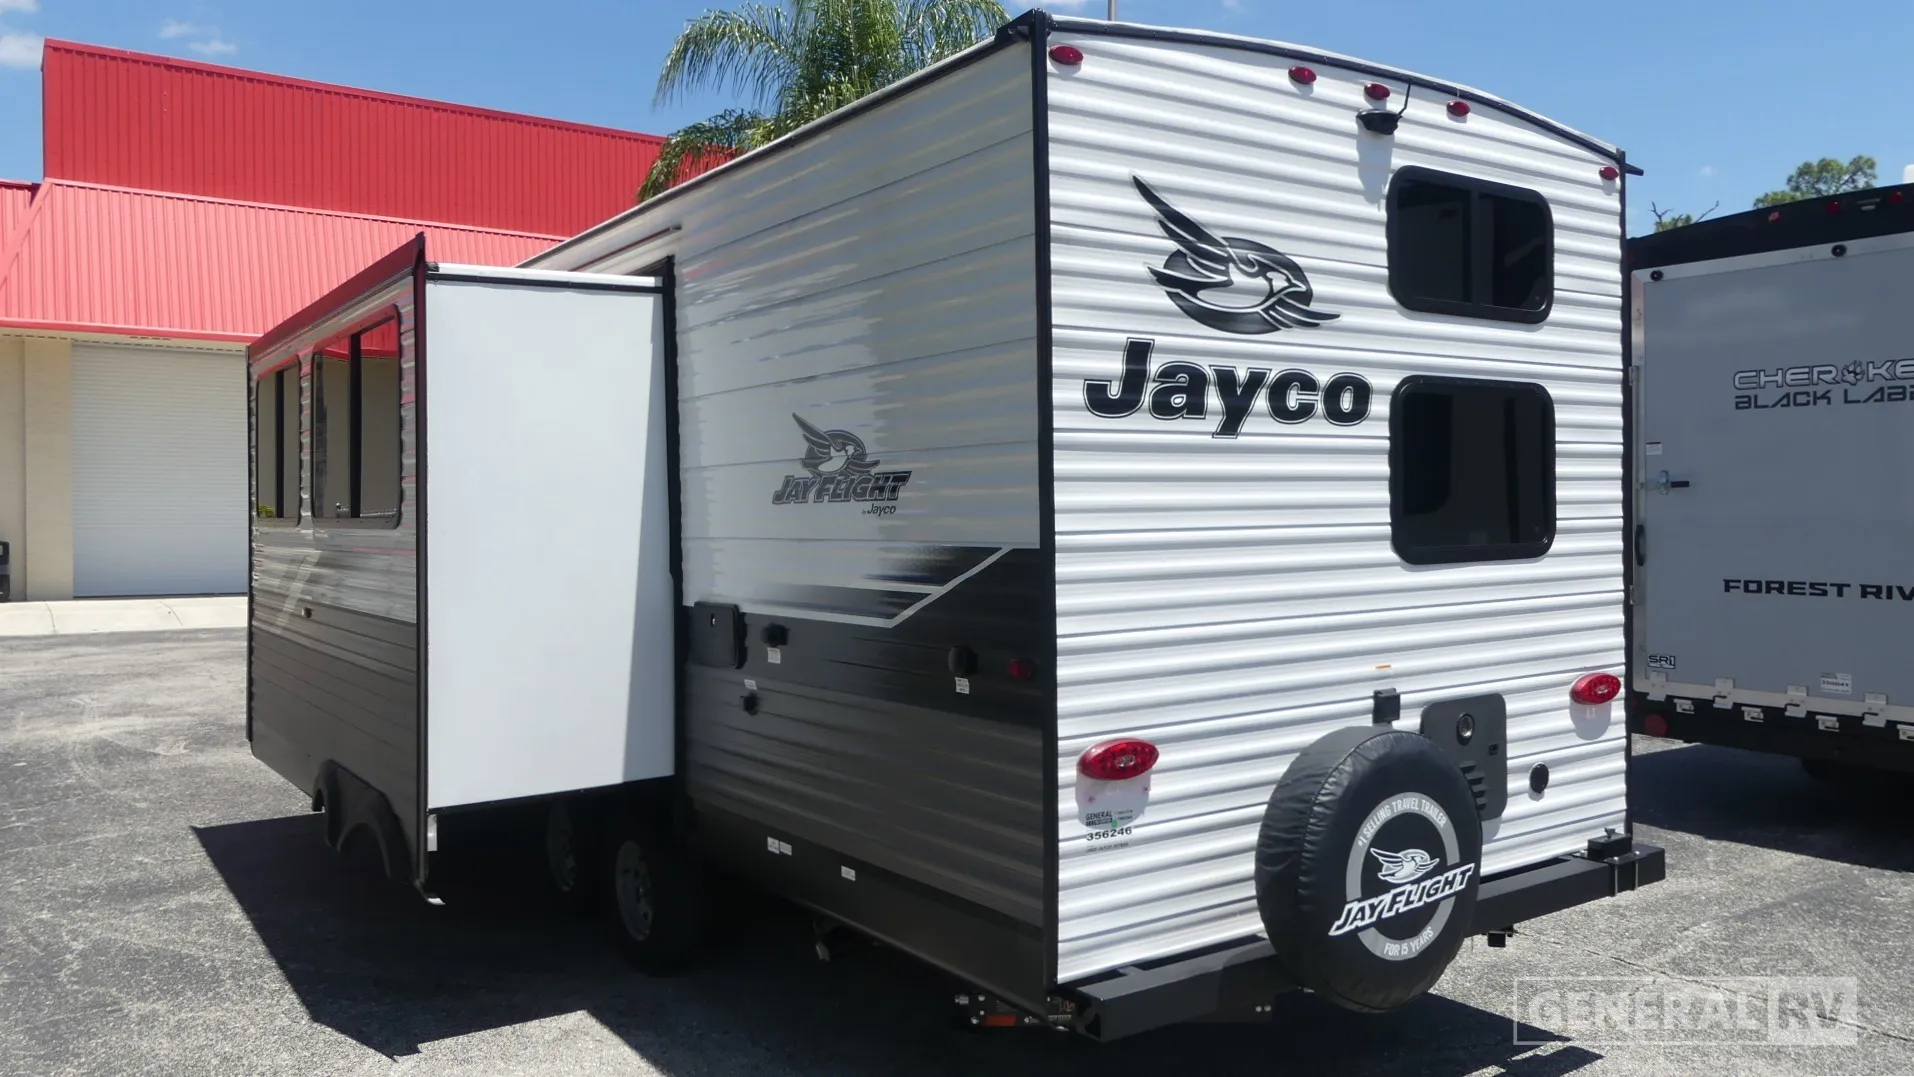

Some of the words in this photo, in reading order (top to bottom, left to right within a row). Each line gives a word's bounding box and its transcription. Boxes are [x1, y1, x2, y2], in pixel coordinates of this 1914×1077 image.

[1083, 337, 1374, 440] Jayco
[1734, 389, 1832, 410] BLACK
[1843, 385, 1914, 405] LAB
[867, 503, 897, 517] Jayco
[1723, 578, 1851, 598] FOREST
[1363, 804, 1392, 838] SELLING
[1392, 797, 1420, 814] TRAVEL
[1421, 799, 1447, 828] TRAILER
[1086, 826, 1133, 841] 356246
[1384, 941, 1401, 957] FOR
[1410, 925, 1435, 953] YEARS
